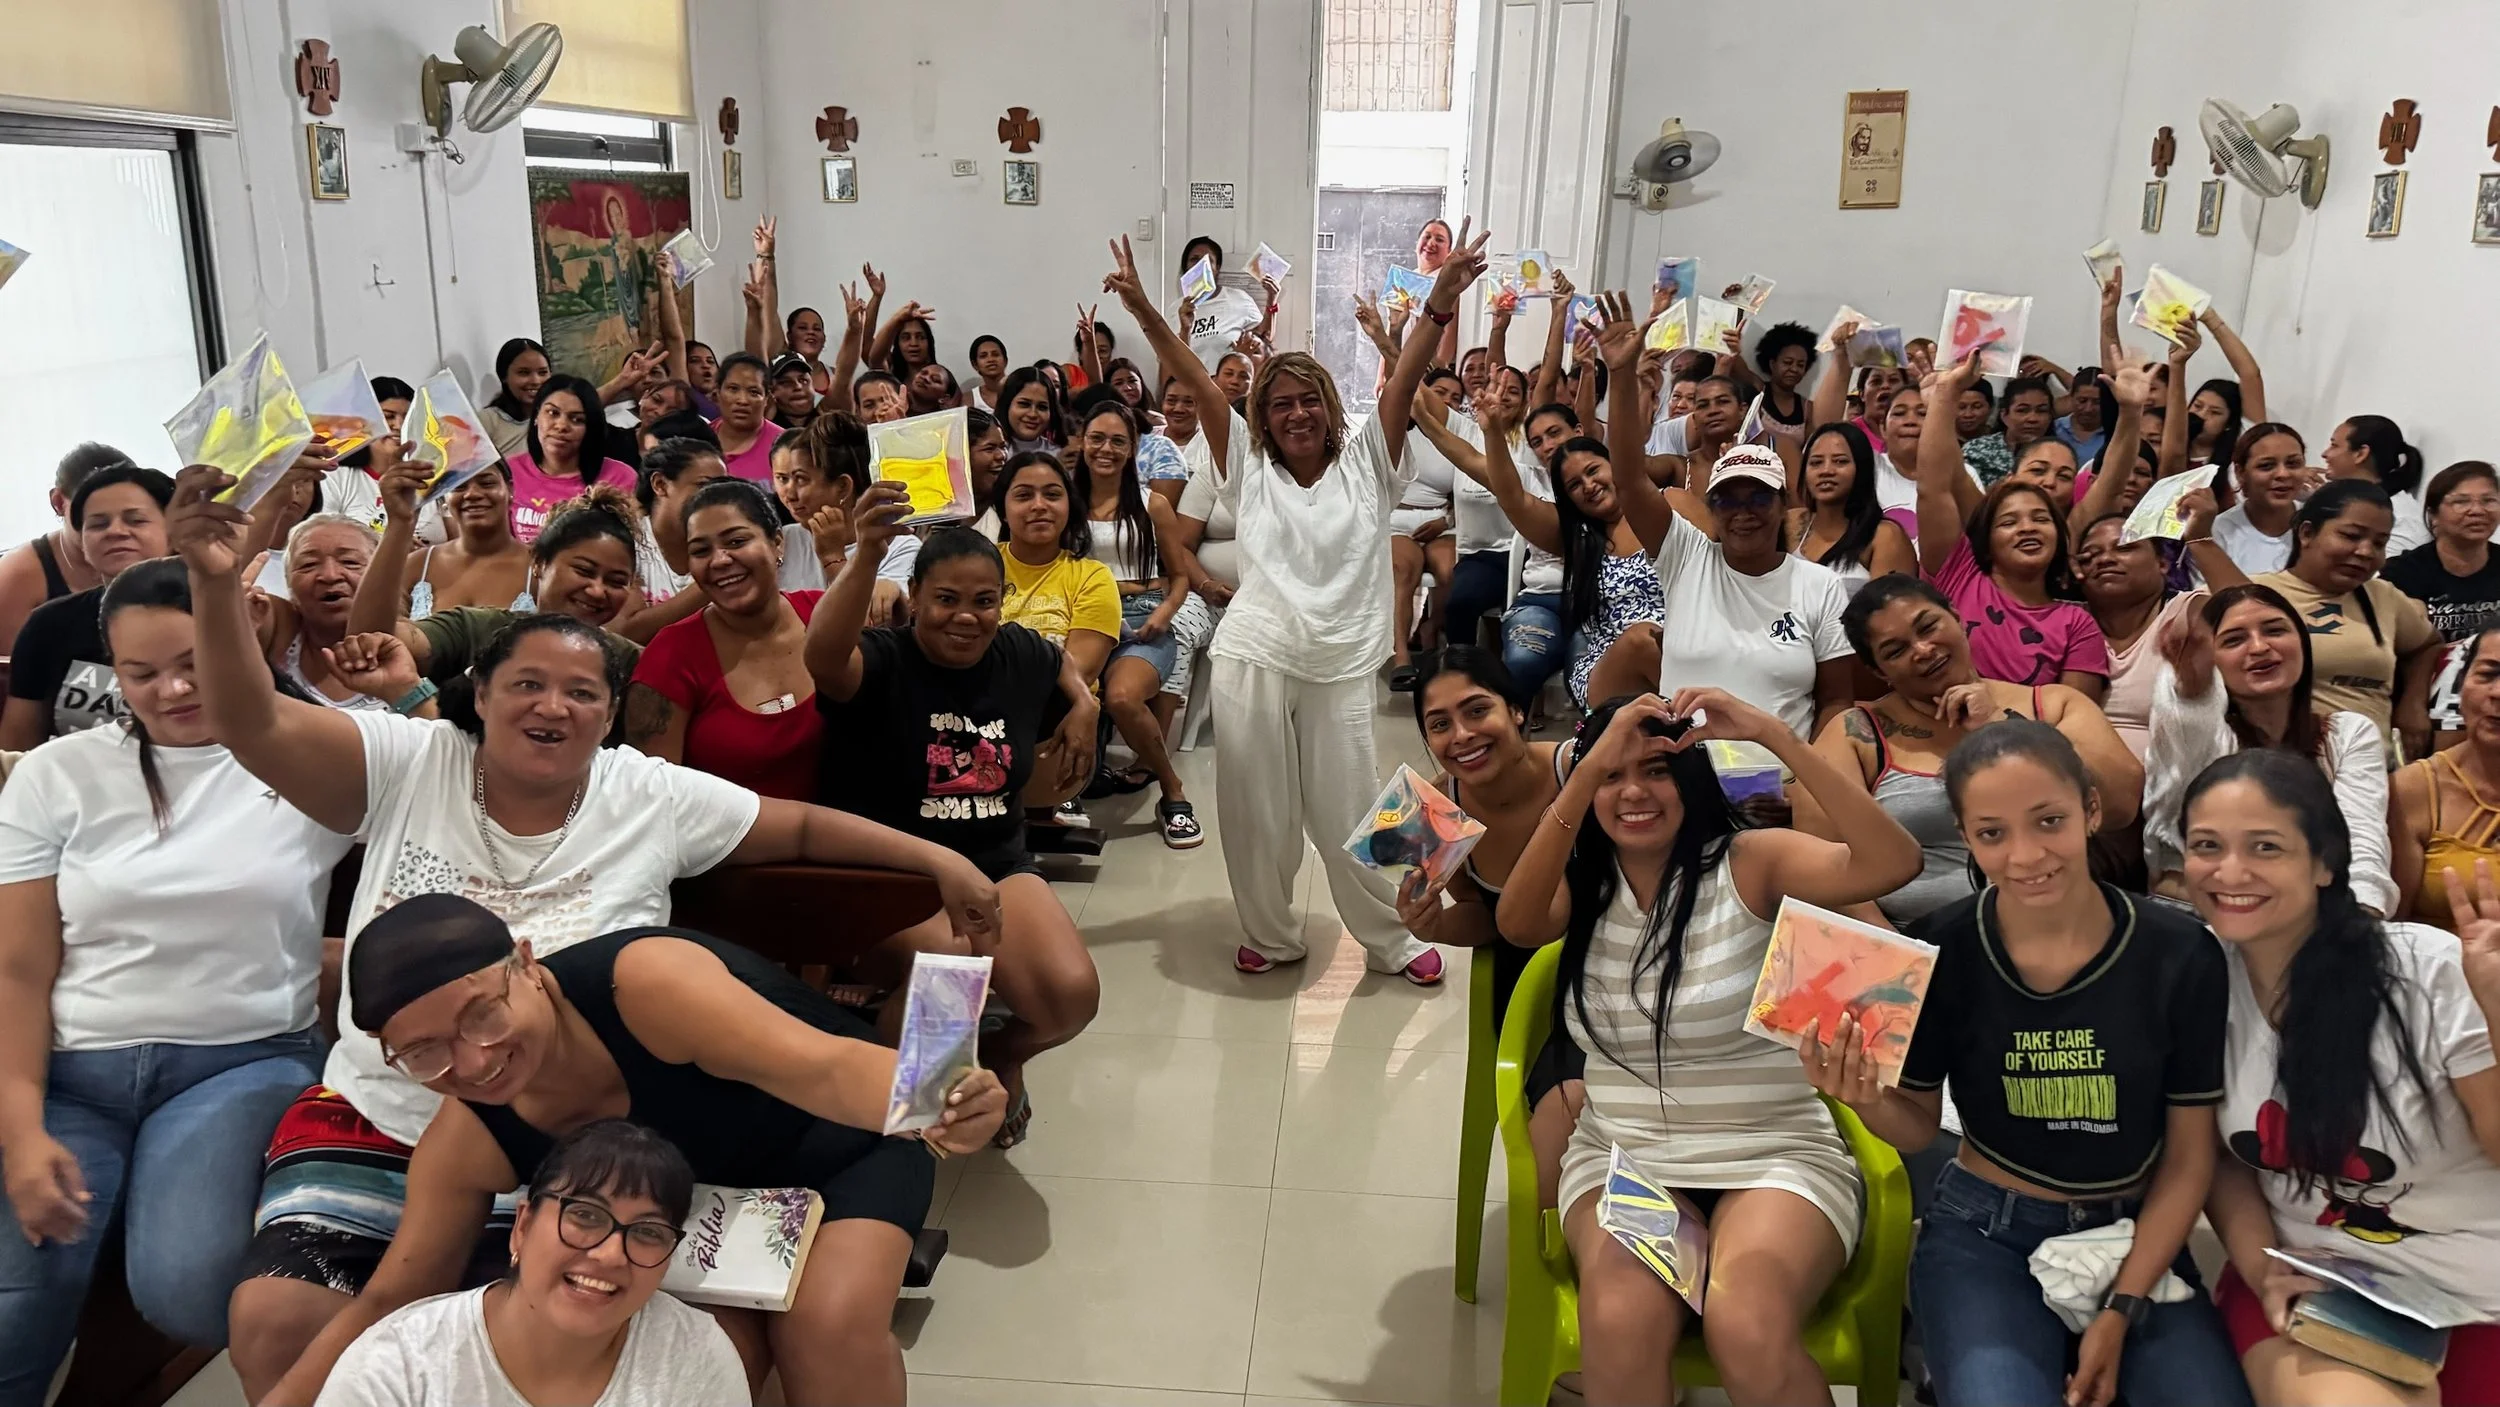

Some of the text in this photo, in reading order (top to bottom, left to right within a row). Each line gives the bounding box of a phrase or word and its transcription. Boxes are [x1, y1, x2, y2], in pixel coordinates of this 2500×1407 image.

[920, 796, 972, 820] SOME
[2013, 1028, 2096, 1051] TAKE CARE
[2005, 1049, 2106, 1072] OF YOURSELF
[2047, 1120, 2119, 1134] MADE IN COLOMBIA
[697, 1192, 727, 1272] Biblia
